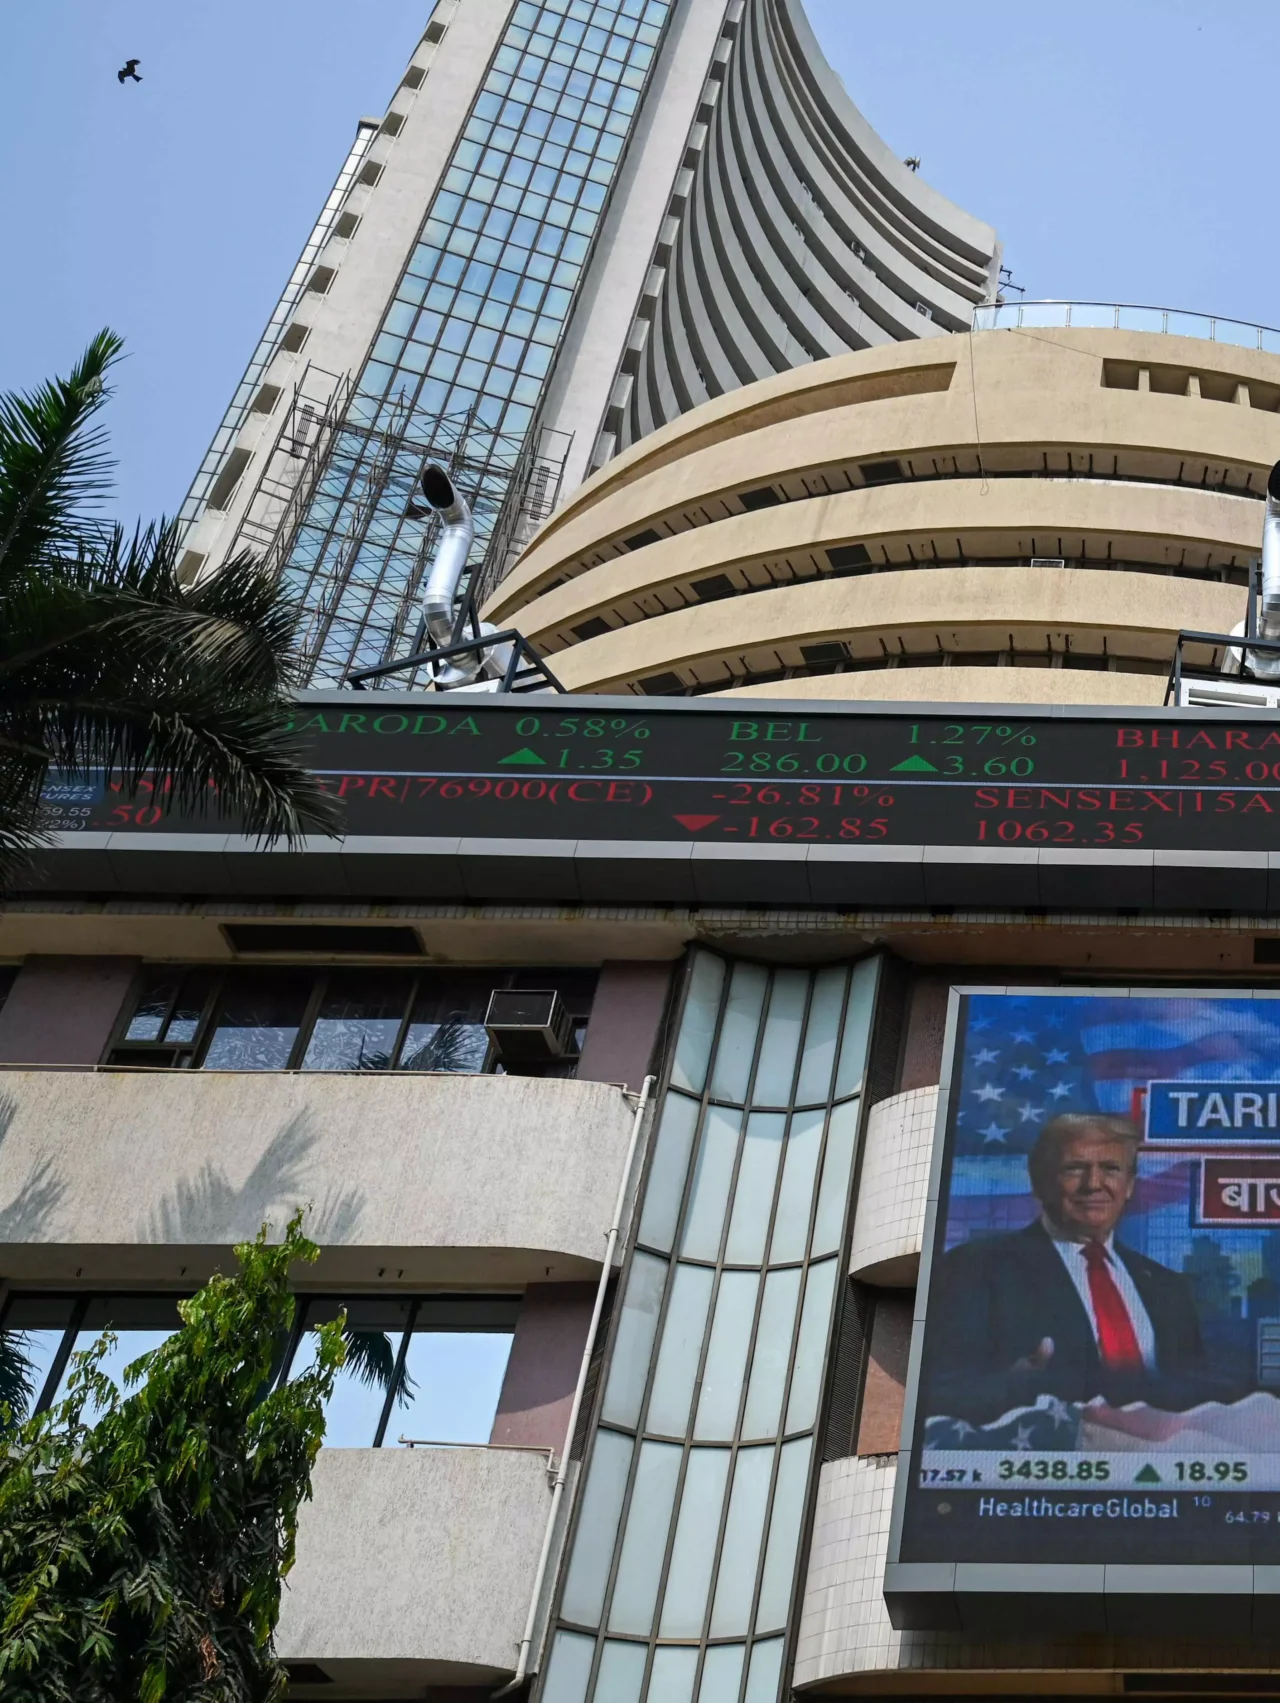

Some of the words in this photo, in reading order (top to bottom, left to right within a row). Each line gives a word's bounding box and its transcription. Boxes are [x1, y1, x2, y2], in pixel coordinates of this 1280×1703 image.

[515, 715, 653, 740] 0.58%
[730, 720, 823, 743] BEL
[910, 723, 1038, 747] 1.27%
[556, 748, 643, 770] 1.35
[721, 750, 869, 774] 286.00
[943, 754, 1036, 777] 3.60
[315, 776, 654, 805] PR|76900(CE)
[711, 783, 896, 808] -26.81%
[722, 815, 890, 841] -162.85
[977, 818, 1145, 844] 1062.35
[999, 1459, 1111, 1480] 3438.85
[1174, 1461, 1249, 1482] 18.95
[978, 1496, 1179, 1518] HealthcareGlobal
[1193, 1495, 1212, 1507] 10
